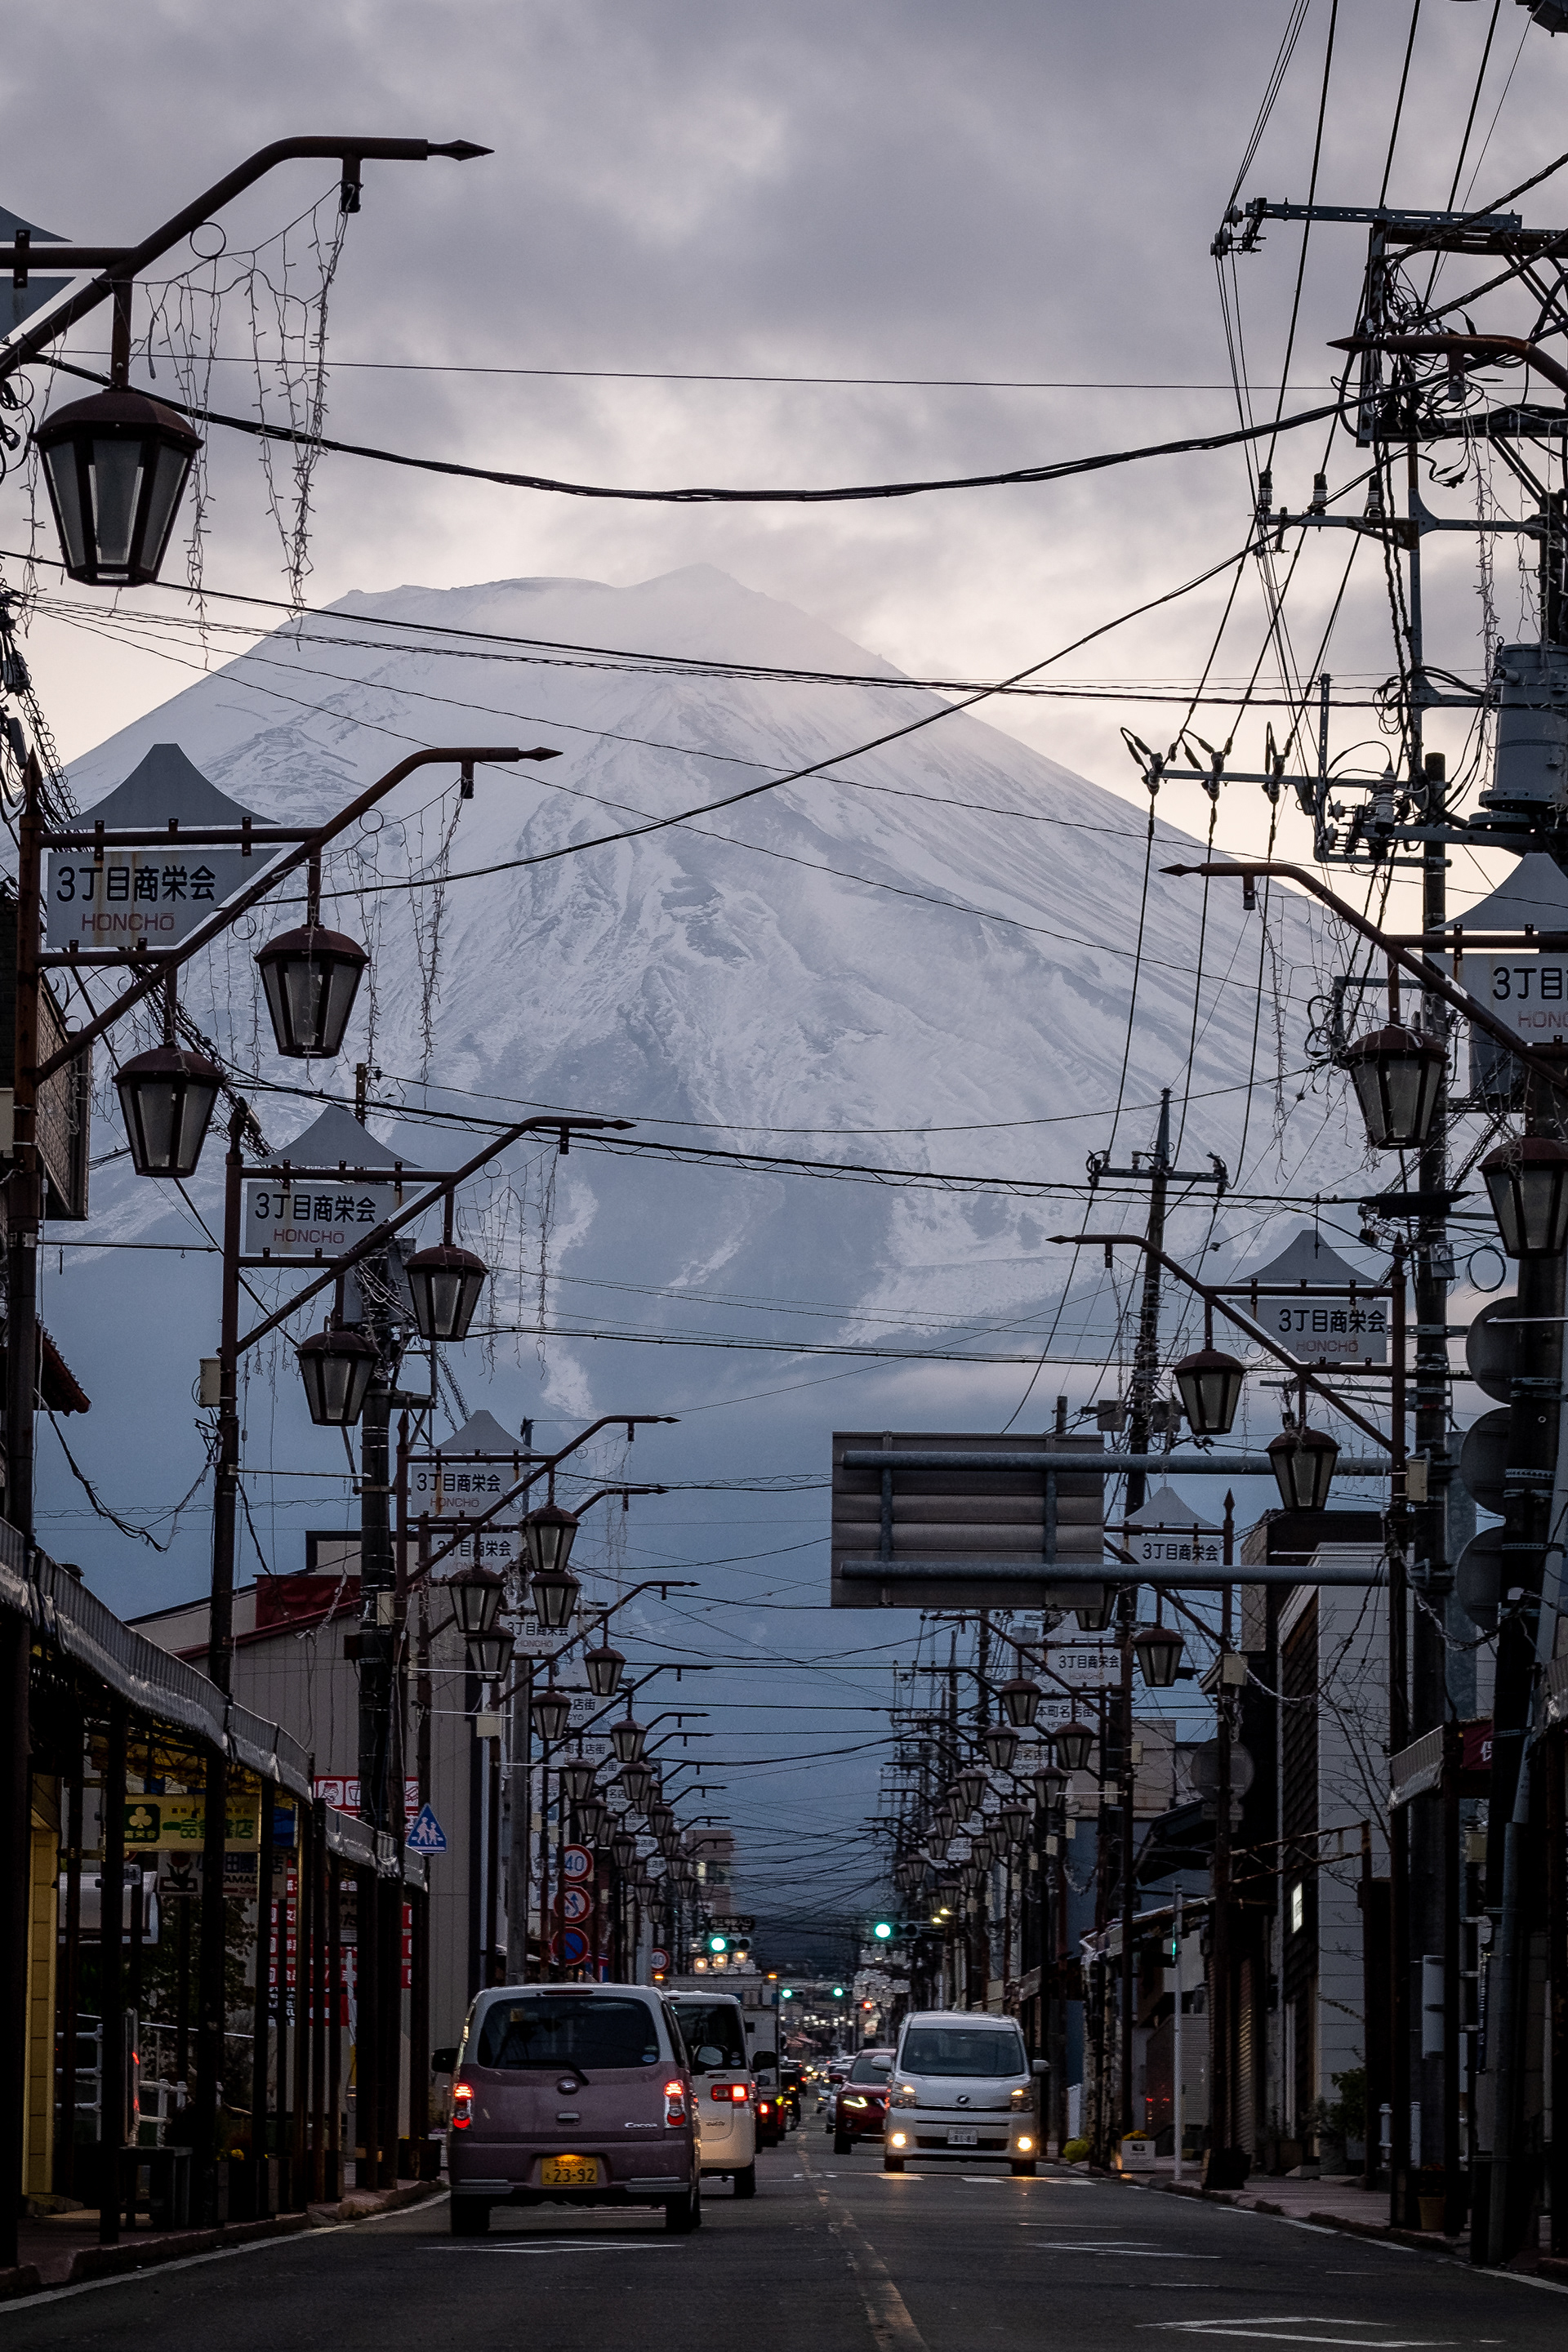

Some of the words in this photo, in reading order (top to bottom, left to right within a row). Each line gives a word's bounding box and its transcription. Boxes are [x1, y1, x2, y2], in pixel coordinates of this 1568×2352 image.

[56, 864, 216, 902] 3丁目商栄会
[1492, 965, 1568, 1001] 3丁目
[255, 1193, 376, 1225] 3丁目商栄会
[1278, 1308, 1386, 1334] 3丁目商栄会
[416, 1472, 501, 1493] 3丁目商栄会
[1143, 1542, 1218, 1561] 3丁目商栄会
[1058, 1655, 1120, 1668] 3丁目商栄会
[564, 1854, 585, 1872] 40
[553, 2167, 595, 2183] 23-92
